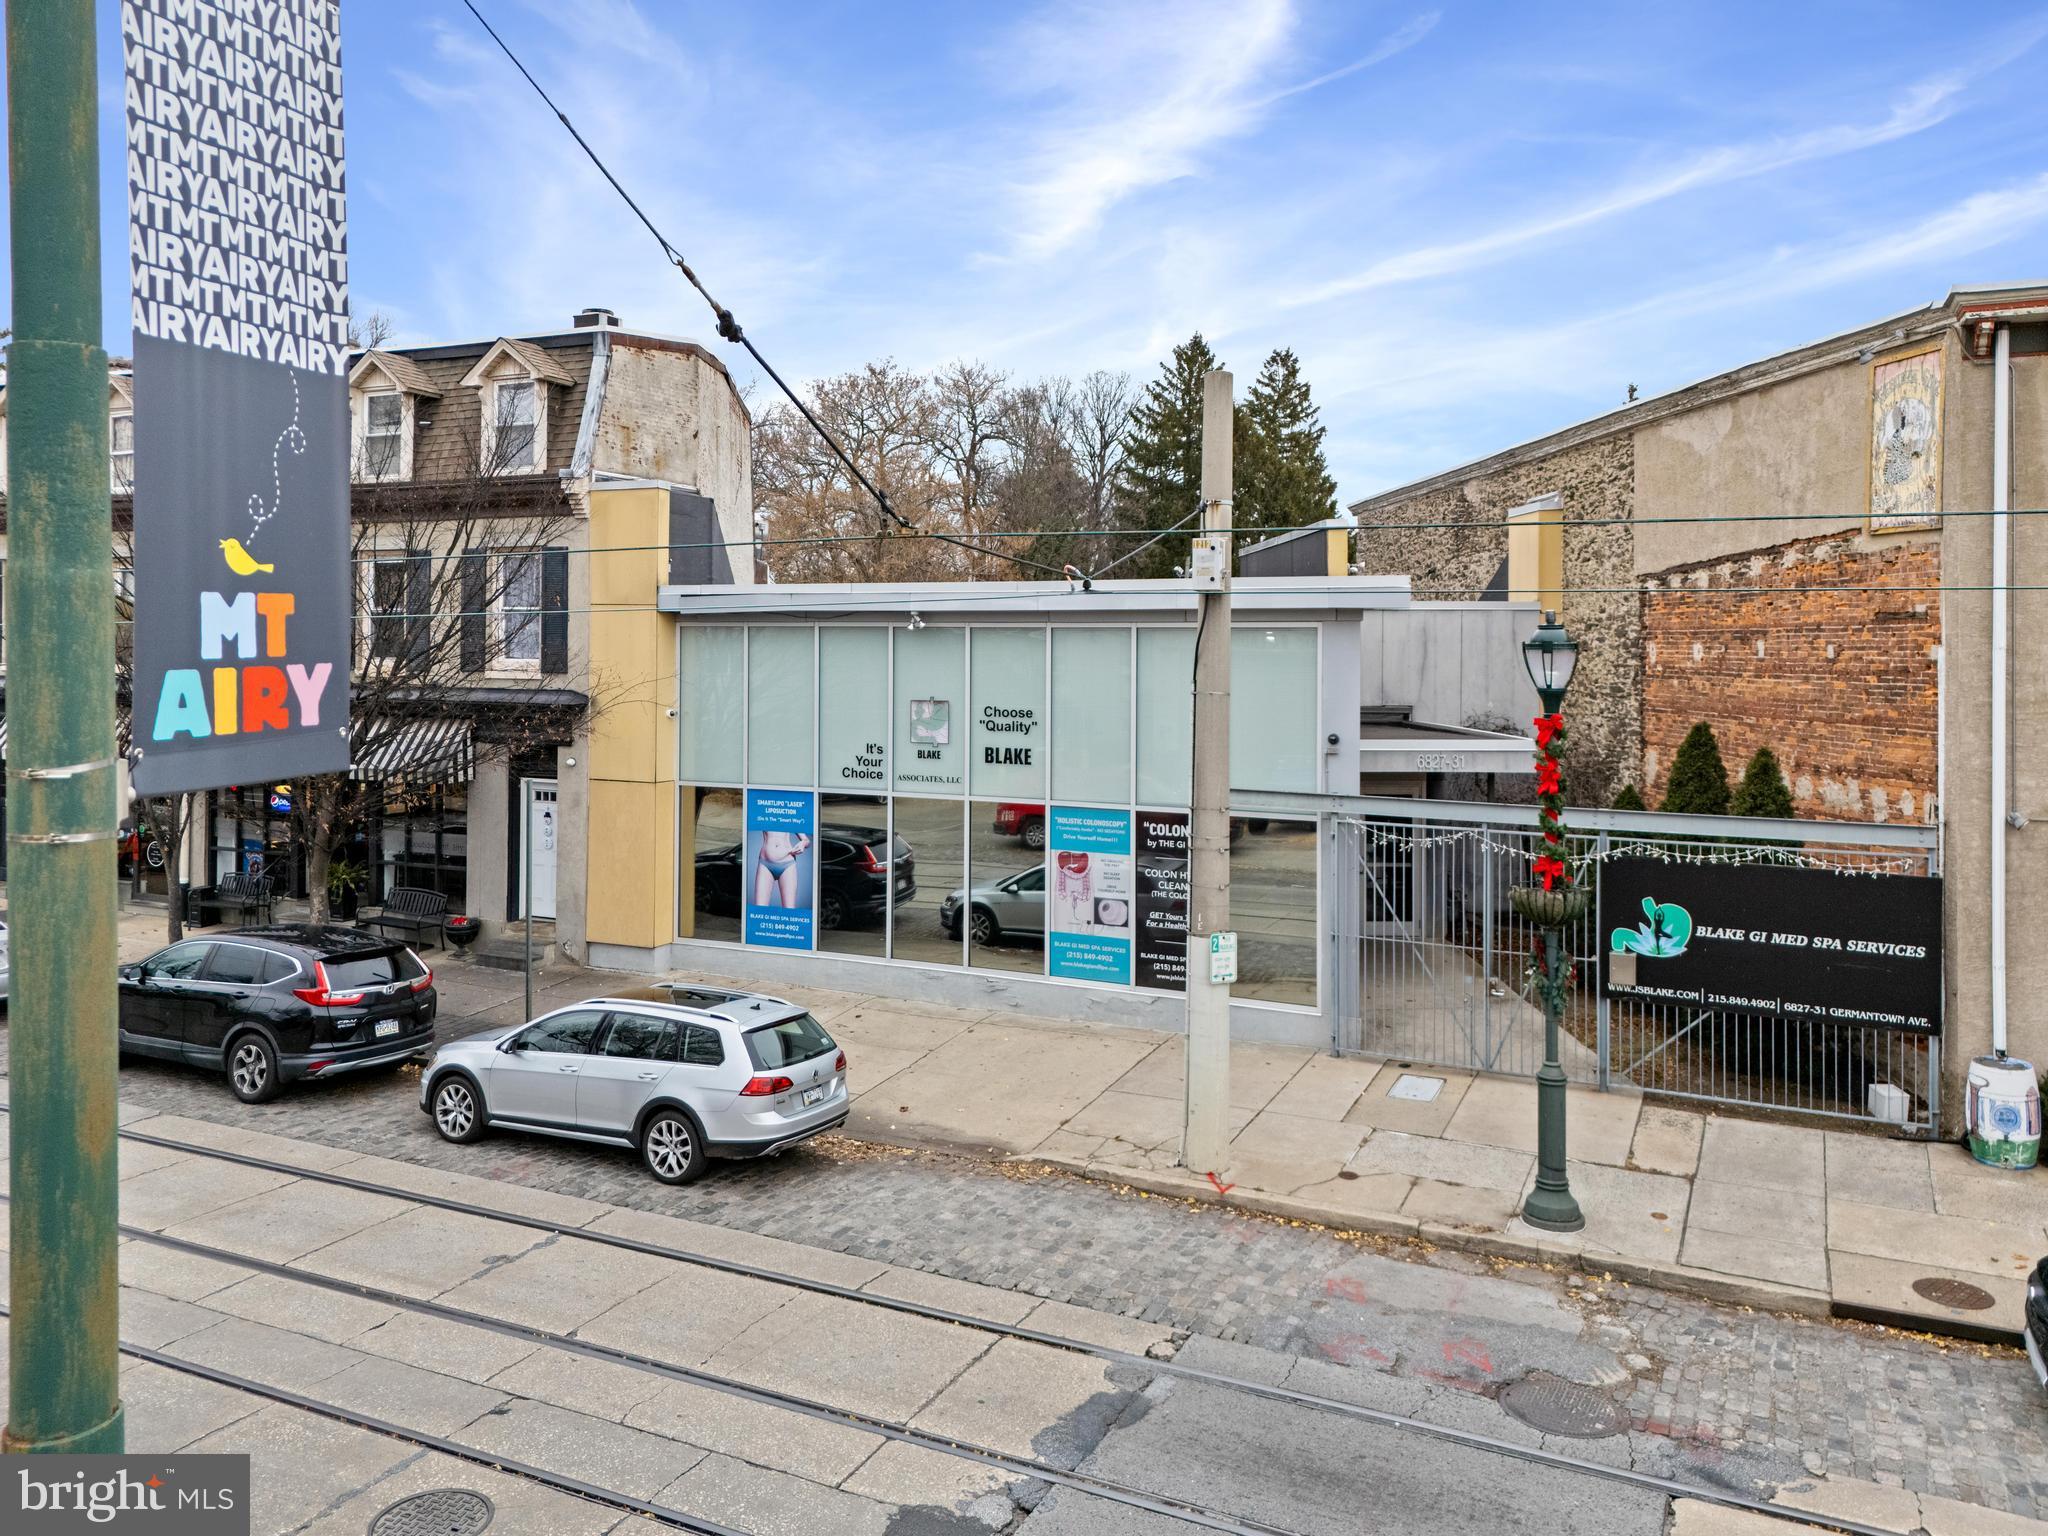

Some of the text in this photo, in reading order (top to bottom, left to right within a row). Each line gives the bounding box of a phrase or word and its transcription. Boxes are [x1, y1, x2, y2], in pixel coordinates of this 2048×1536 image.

[200, 591, 296, 660] MT
[152, 662, 333, 742] AIRY
[984, 706, 1034, 719] Choose
[979, 720, 1038, 736] "Quality"
[866, 743, 884, 754] It's
[917, 750, 942, 760] BLAKE
[984, 747, 1032, 766] BLAKE
[855, 756, 884, 767] Your
[1417, 754, 1465, 768] 6827-31
[842, 767, 884, 780] Choice
[897, 774, 962, 784] ASSOCIATES, LLC
[765, 807, 797, 815] LIPOSUCTION
[1147, 838, 1186, 849] by THE GI
[1144, 868, 1178, 879] COLON
[1149, 911, 1164, 920] GET
[1165, 912, 1184, 921] Yours
[1146, 919, 1158, 928] For
[1212, 937, 1219, 951] 2
[1695, 926, 1927, 958] BLAKE GI MED SPA SERVICES
[1101, 945, 1127, 954] SERVICES
[1066, 951, 1113, 962] (215) 849-4902
[1140, 952, 1158, 960] BLAKE
[1153, 962, 1171, 971] (215)
[1607, 983, 1931, 1028] WWW.JSBLAKE.COM 215.849.4902 6827-31 GERMANTOWN AVE.
